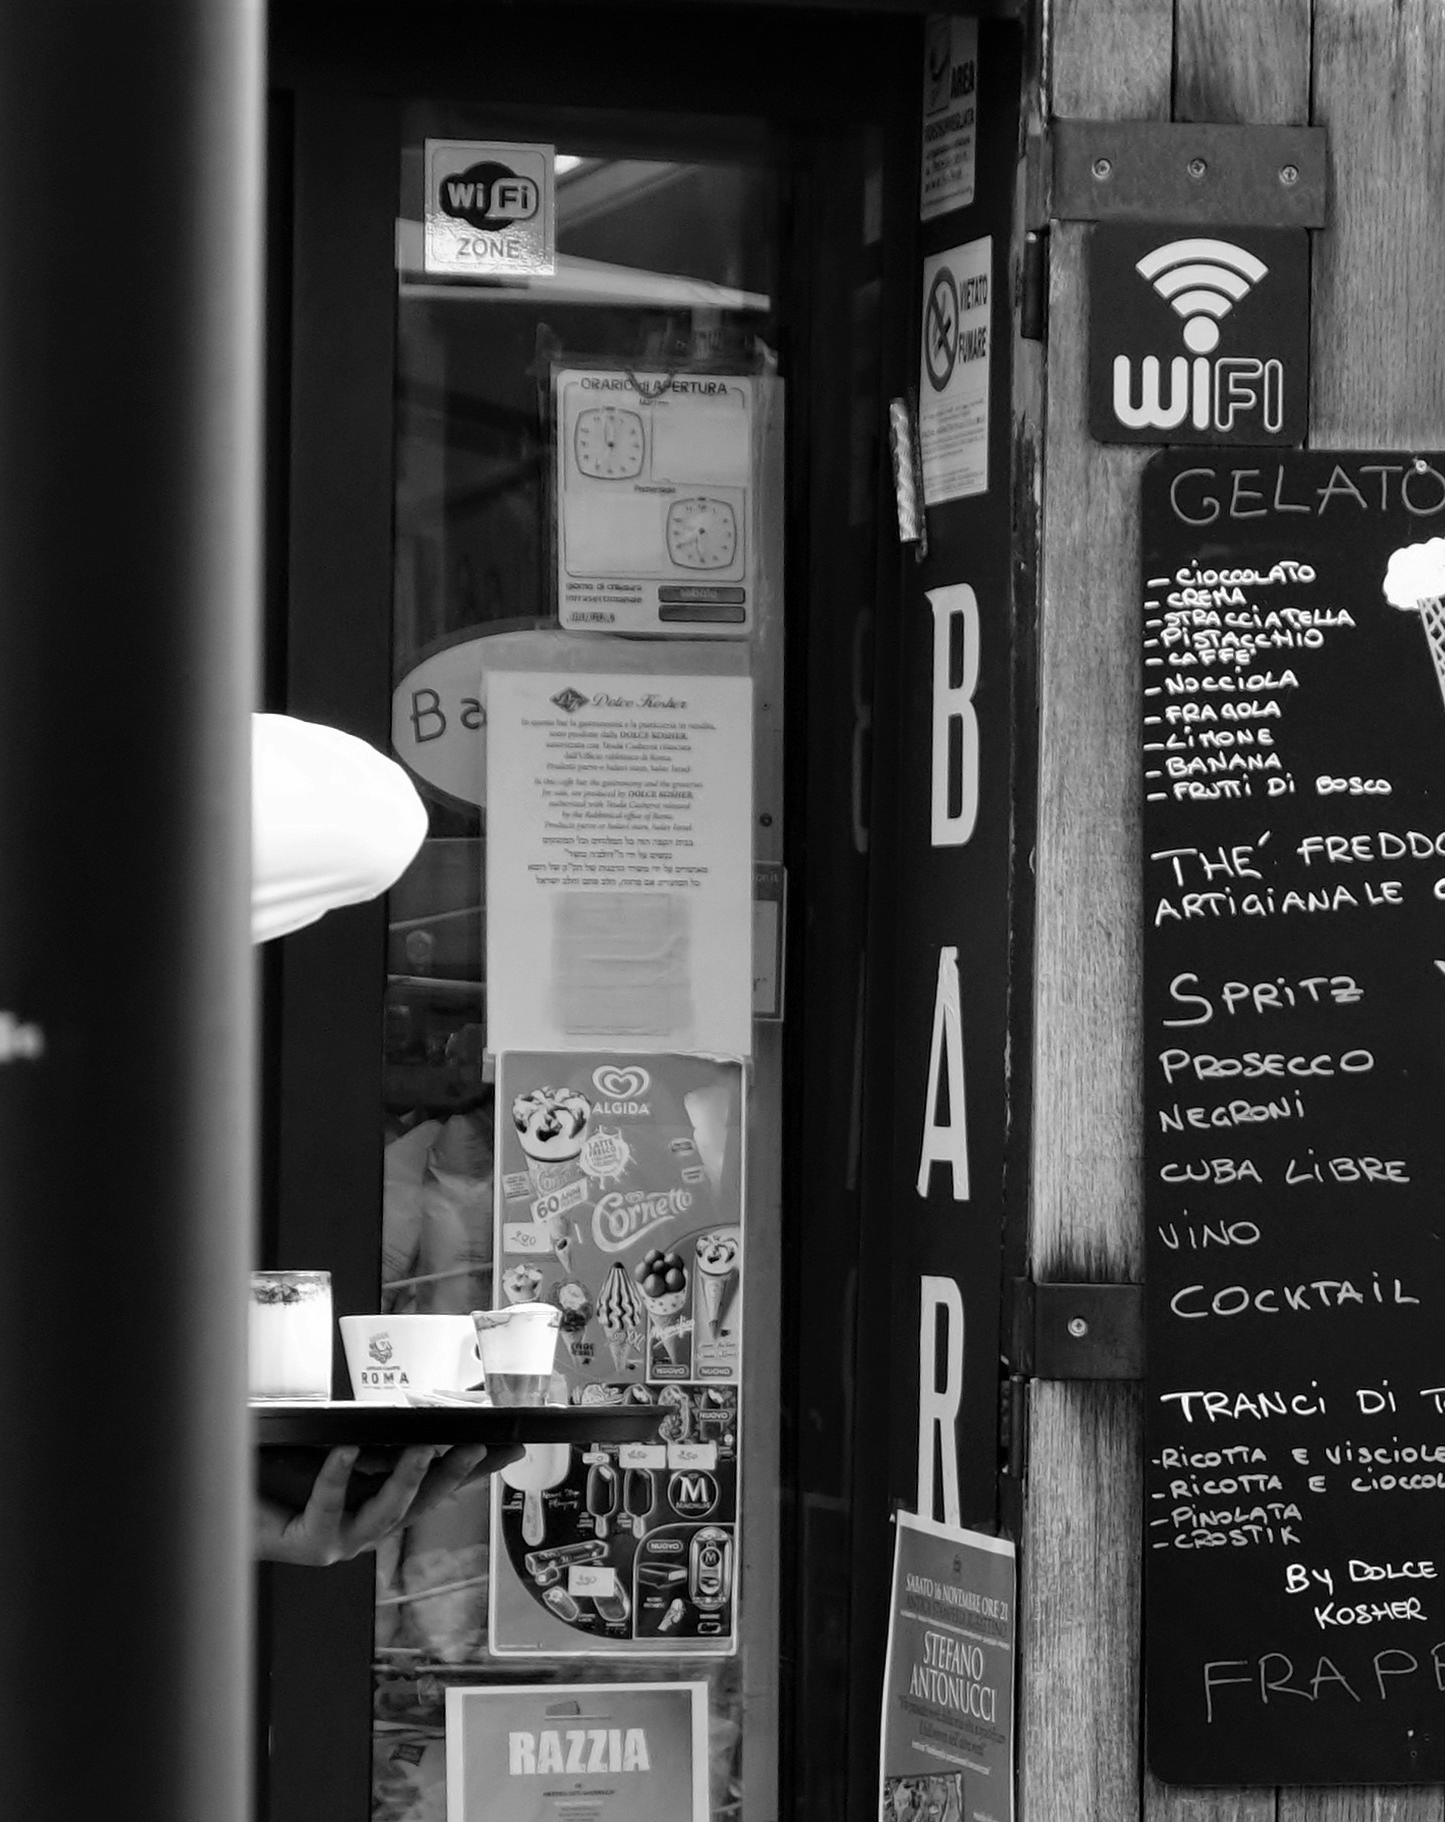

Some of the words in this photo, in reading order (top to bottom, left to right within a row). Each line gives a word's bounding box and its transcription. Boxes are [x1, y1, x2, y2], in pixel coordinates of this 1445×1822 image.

[457, 238, 522, 258] ZONE
[959, 273, 988, 312] VIETATO
[957, 325, 987, 364] FUMARE
[580, 377, 640, 391] ORARIO
[592, 692, 634, 709] Dolce
[636, 693, 689, 710] Kosher
[1314, 773, 1394, 797] BOSCO
[1157, 1047, 1376, 1085] PROSECCO
[591, 1101, 650, 1116] ALGIDA
[1157, 1088, 1307, 1134] NEGRONI
[1158, 1158, 1263, 1185] CUBA
[1283, 1146, 1412, 1186] LIBRE
[536, 1194, 560, 1219] 60
[591, 1187, 693, 1252] Cornetto
[1157, 1206, 1262, 1251] VINO
[1169, 1270, 1422, 1320] COCKTAIL
[361, 1371, 411, 1385] ROMA
[699, 1411, 729, 1420] NUOVO
[1159, 1378, 1327, 1424] TRANCI
[1290, 1446, 1311, 1466] E
[678, 1476, 710, 1502] M
[1307, 1474, 1328, 1494] E
[650, 1542, 680, 1551] NUOVO
[1346, 1558, 1440, 1585] DOLCE
[905, 1573, 934, 1599] SABATO
[942, 1584, 981, 1613] NOVEMBRE
[981, 1595, 1000, 1619] ORE
[1000, 1601, 1010, 1622] 21
[1312, 1596, 1429, 1631] KOSHER
[923, 1630, 985, 1682] STEFANO
[909, 1662, 997, 1724] ANTONUCCI
[508, 1727, 651, 1776] RAZZIA
